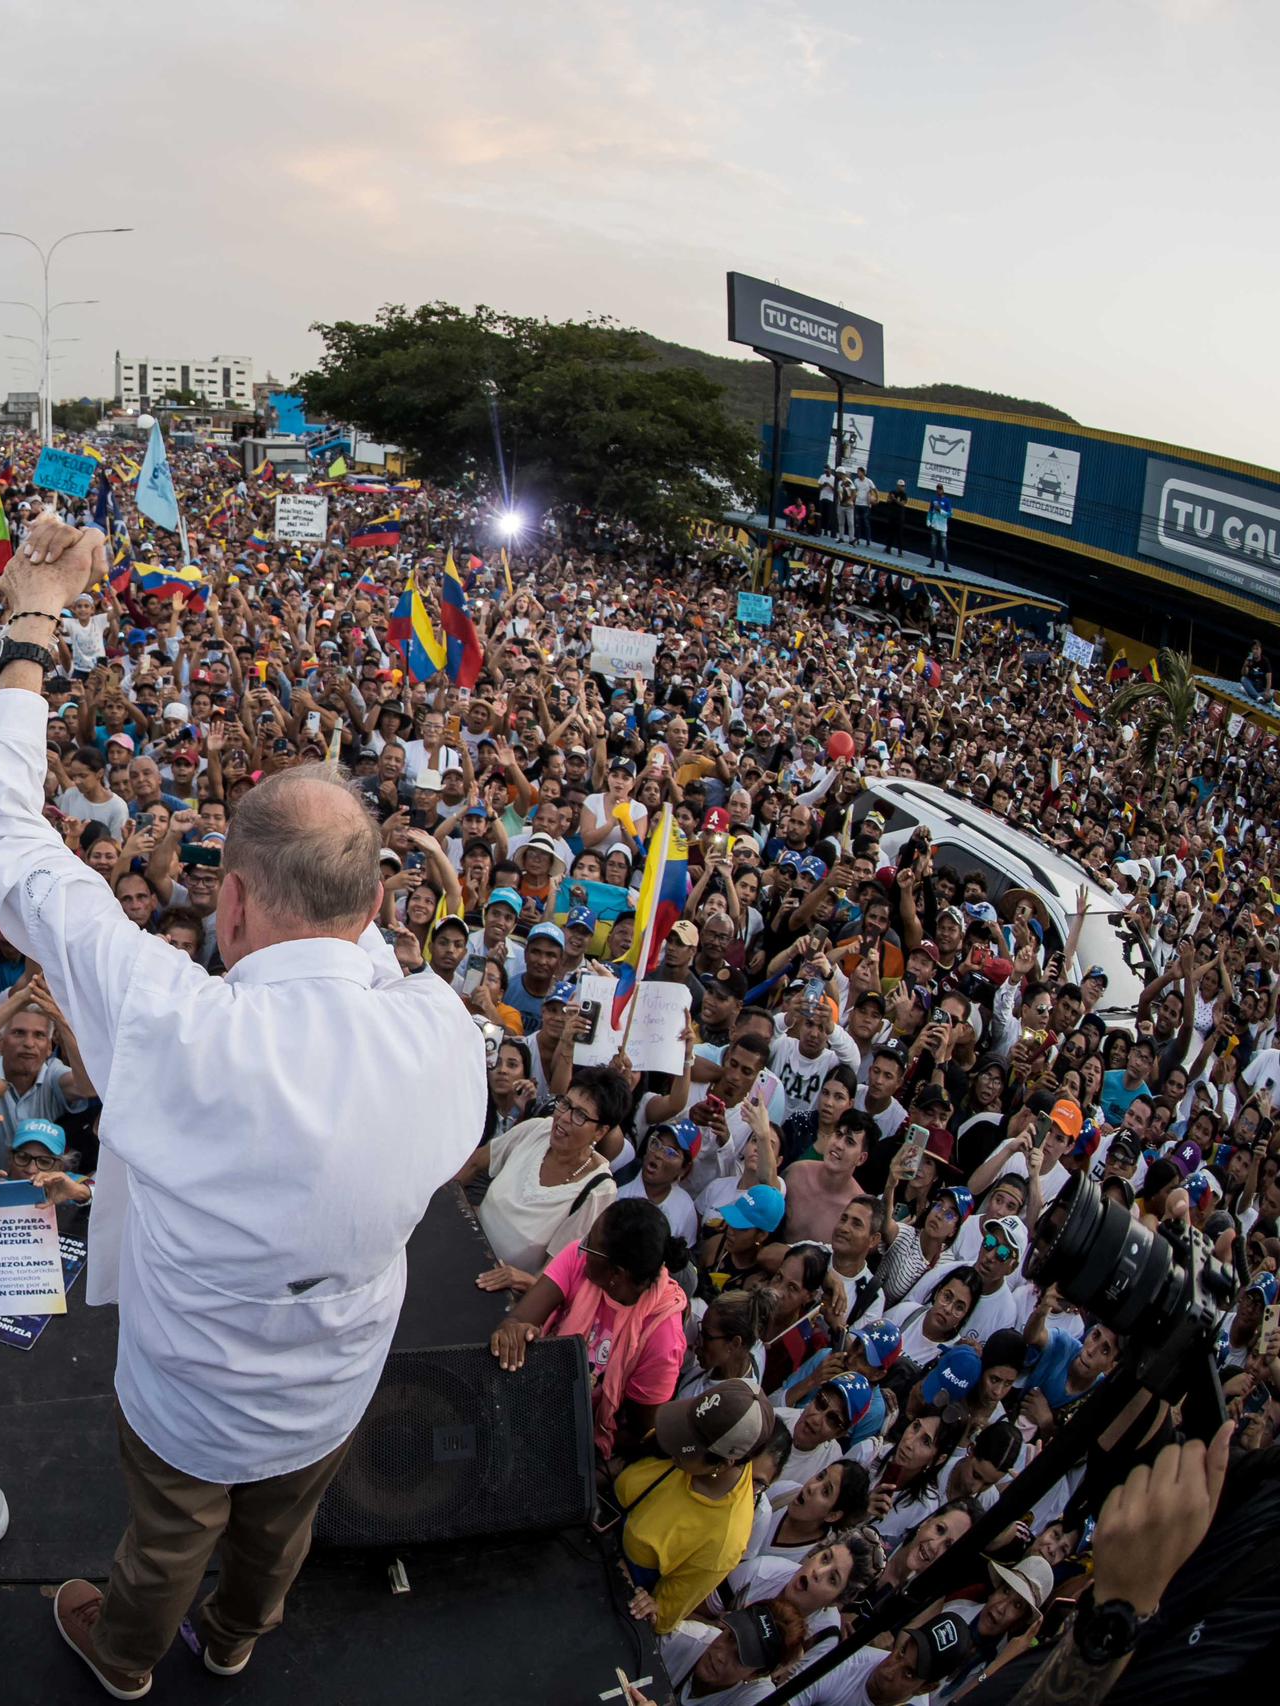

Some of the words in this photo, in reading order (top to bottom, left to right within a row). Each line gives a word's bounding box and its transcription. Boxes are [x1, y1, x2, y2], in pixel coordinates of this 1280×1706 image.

[766, 309, 786, 327] TU
[1021, 498, 1072, 518] AUTOLAVADO
[1172, 499, 1215, 538] TU
[780, 1063, 820, 1104] GAP
[65, 1238, 85, 1248] POR
[68, 1246, 87, 1257] POR
[8, 1288, 60, 1296] CRIMINAL
